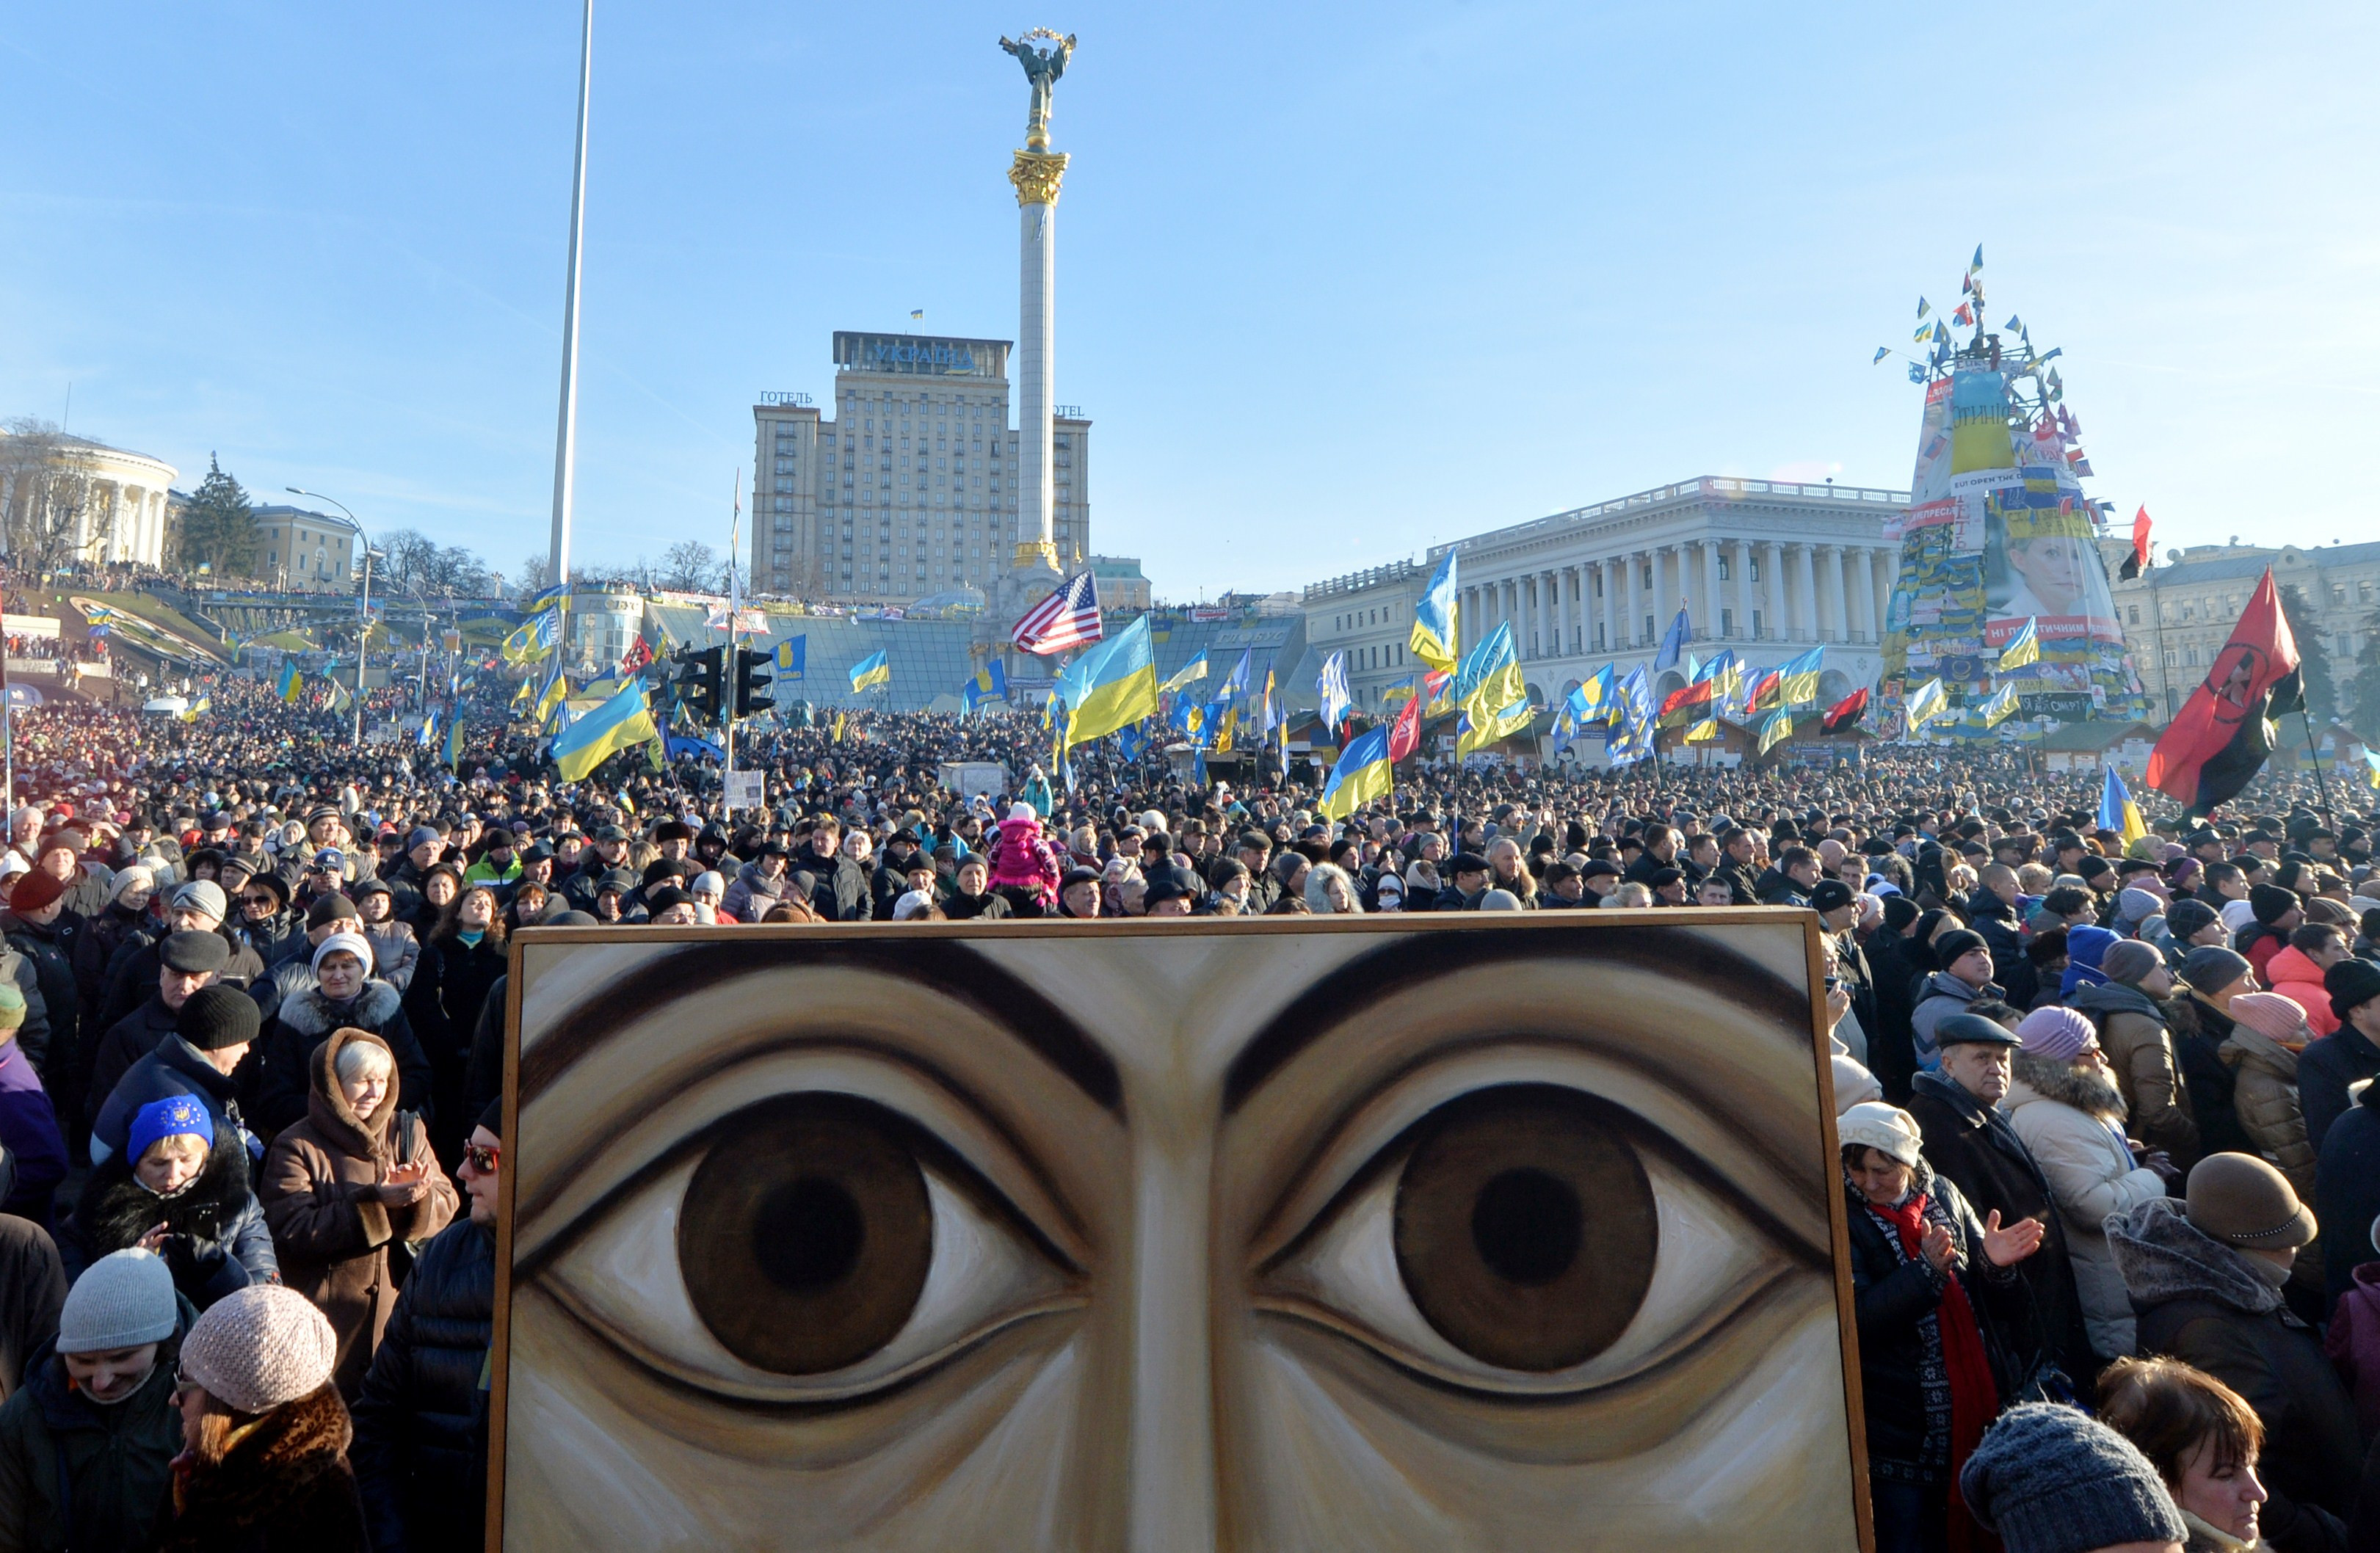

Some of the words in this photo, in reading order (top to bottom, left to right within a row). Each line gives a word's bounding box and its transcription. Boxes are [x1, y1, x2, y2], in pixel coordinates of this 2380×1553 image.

[874, 343, 974, 366] УКРАЇНА
[760, 390, 813, 403] ГОТЕЛЬ
[1053, 404, 1086, 417] OTEL
[1970, 476, 1995, 486] OPEN
[1216, 630, 1287, 644] ГЛОБУС
[1992, 628, 2004, 639] НІ
[2009, 625, 2086, 637] ПТИЧНИМ
